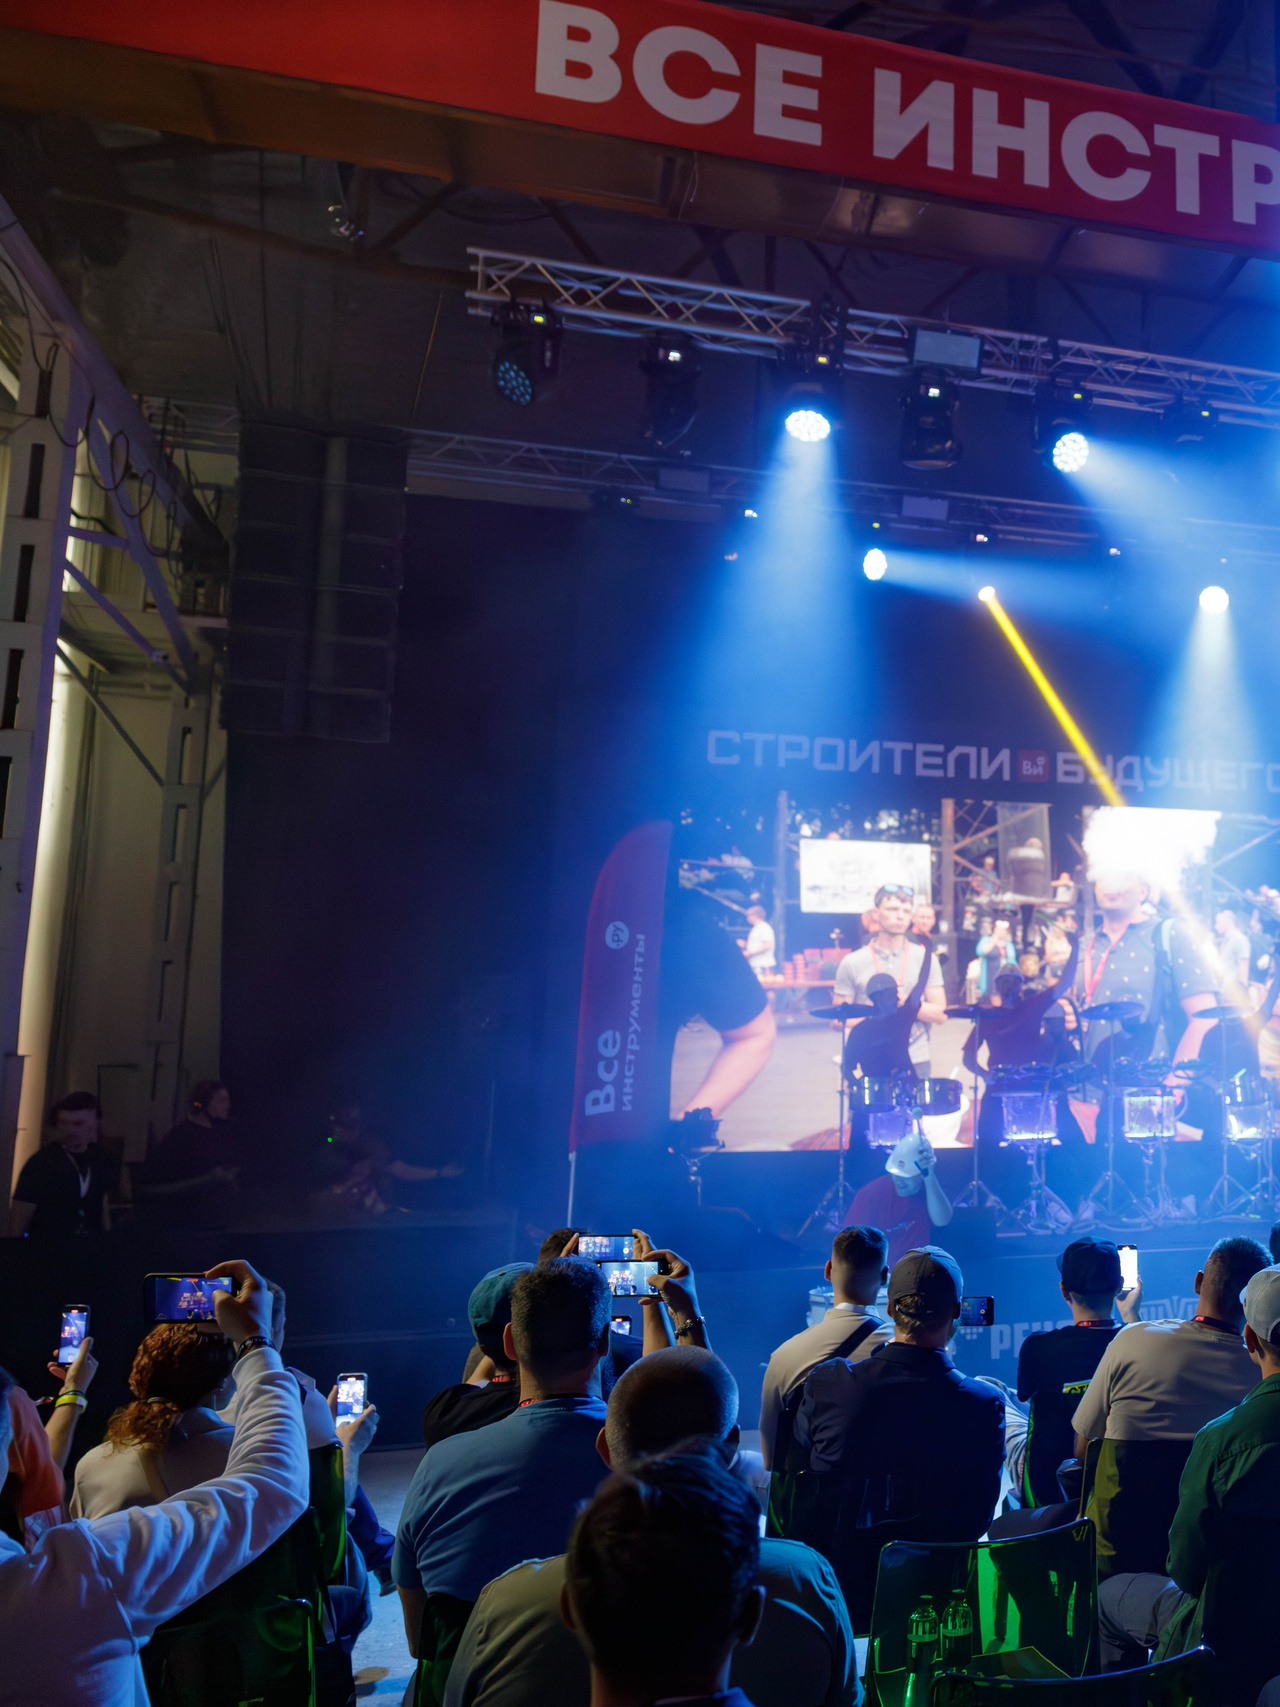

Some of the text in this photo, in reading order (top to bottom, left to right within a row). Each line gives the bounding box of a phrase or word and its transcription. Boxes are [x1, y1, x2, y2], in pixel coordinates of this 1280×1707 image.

[535, 0, 823, 147] ВСЕ
[706, 730, 1012, 781] СТРОИТЕЛИ
[585, 1029, 621, 1117] Все
[622, 933, 645, 1111] инструменты
